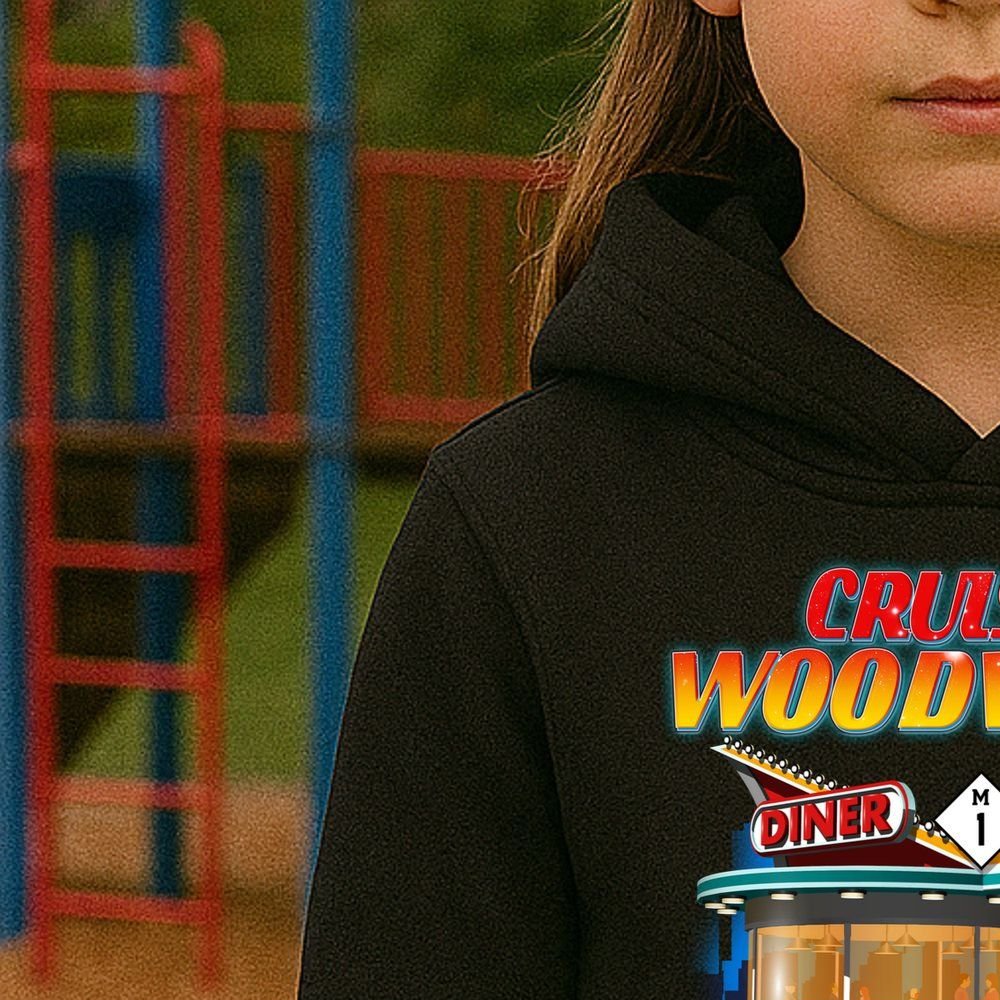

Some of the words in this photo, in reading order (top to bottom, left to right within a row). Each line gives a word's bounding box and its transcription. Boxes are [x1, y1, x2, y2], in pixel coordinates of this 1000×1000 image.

[972, 789, 989, 805] M
[760, 793, 893, 849] DINER
[977, 812, 985, 846] 1
